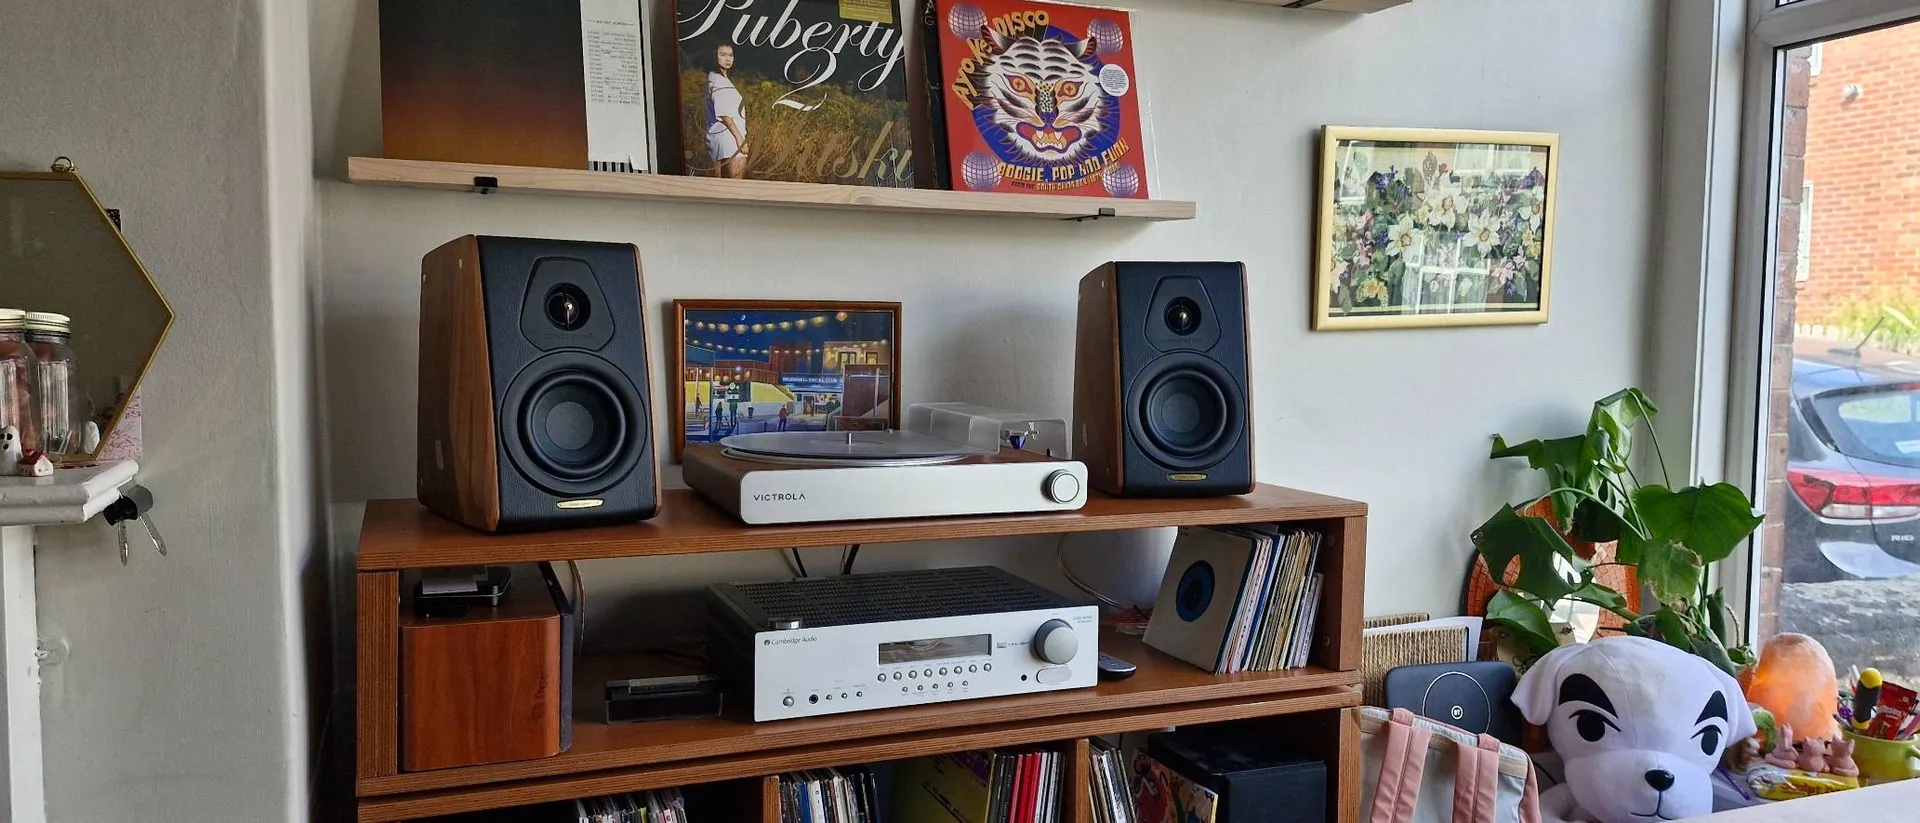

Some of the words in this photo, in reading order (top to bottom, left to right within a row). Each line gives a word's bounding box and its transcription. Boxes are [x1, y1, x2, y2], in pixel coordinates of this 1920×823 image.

[992, 9, 1050, 38] DISCO
[678, 0, 907, 92] Puberty
[1051, 164, 1076, 182] POP
[753, 493, 806, 501] VICTROLA
